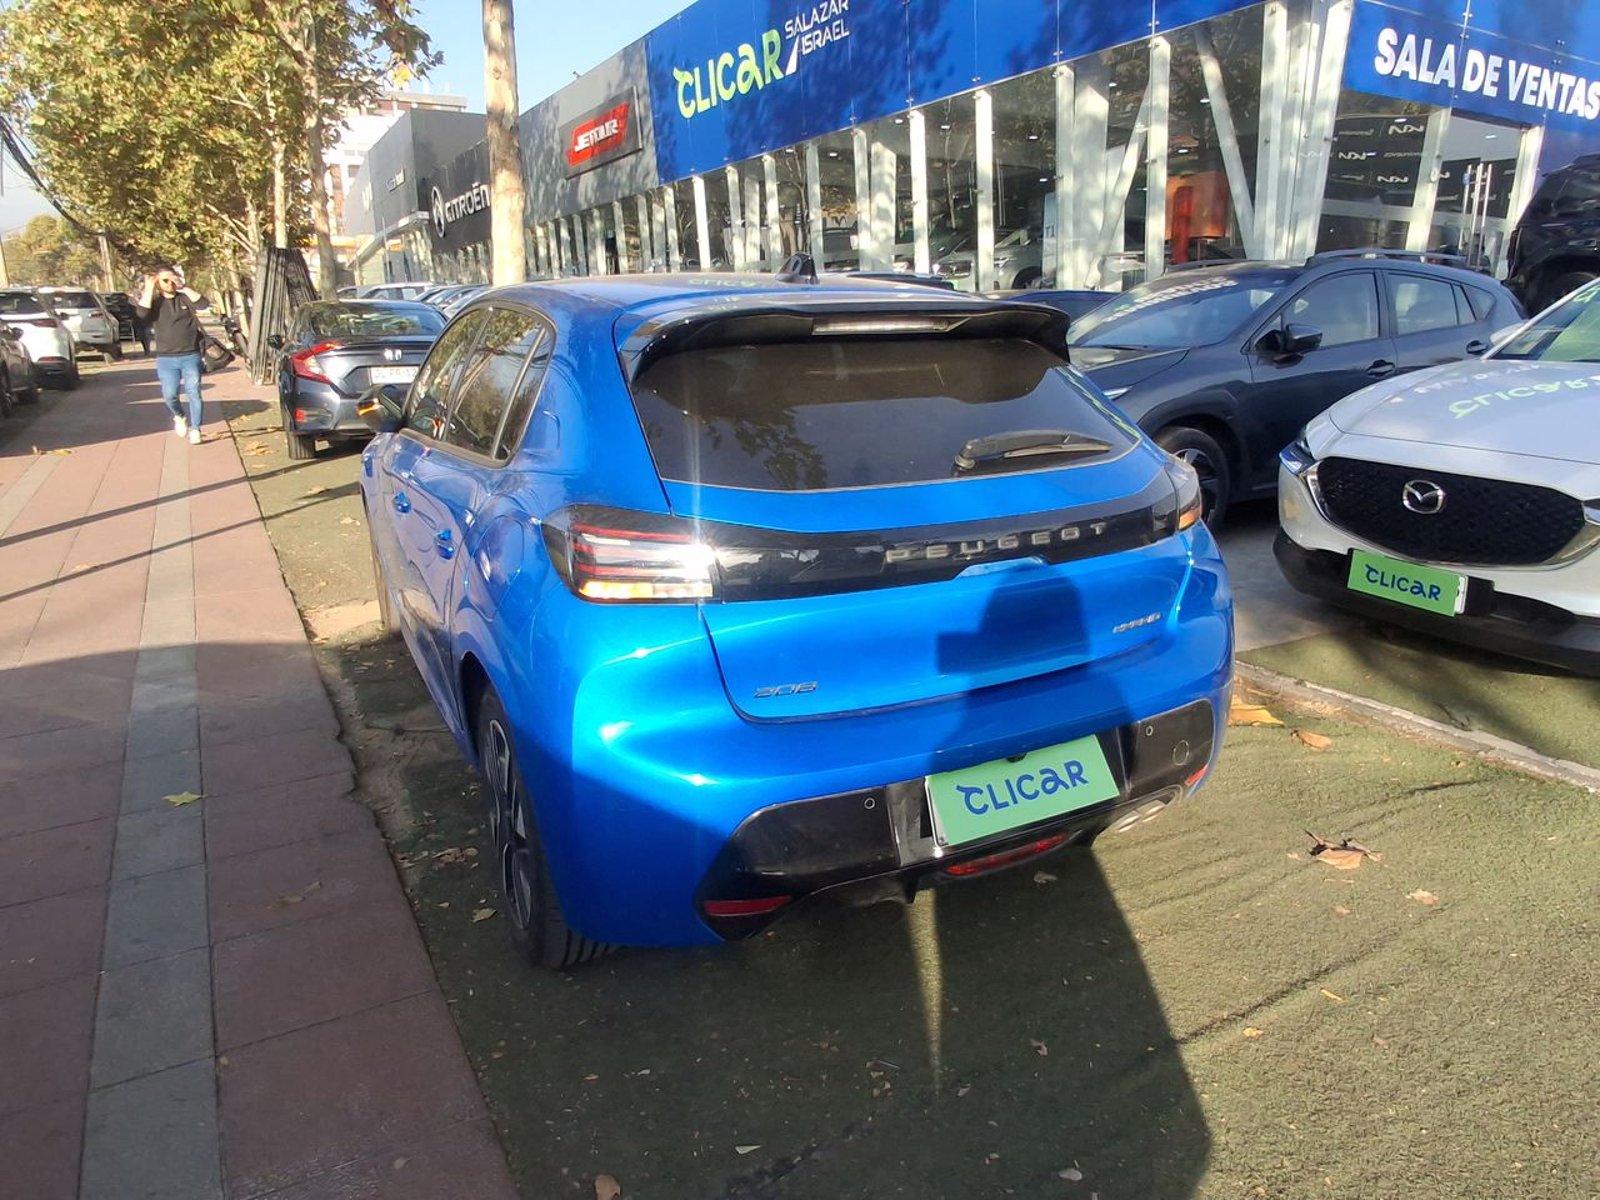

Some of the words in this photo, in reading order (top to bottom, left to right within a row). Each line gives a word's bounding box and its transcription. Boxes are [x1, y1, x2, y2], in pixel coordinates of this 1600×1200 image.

[784, 0, 849, 40] SALAZAR
[801, 18, 849, 57] ISRAEL
[1374, 28, 1456, 88] SALA
[1462, 49, 1503, 97] DE
[1507, 60, 1600, 120] VENTAS
[885, 521, 1107, 563] PEUGEOT
